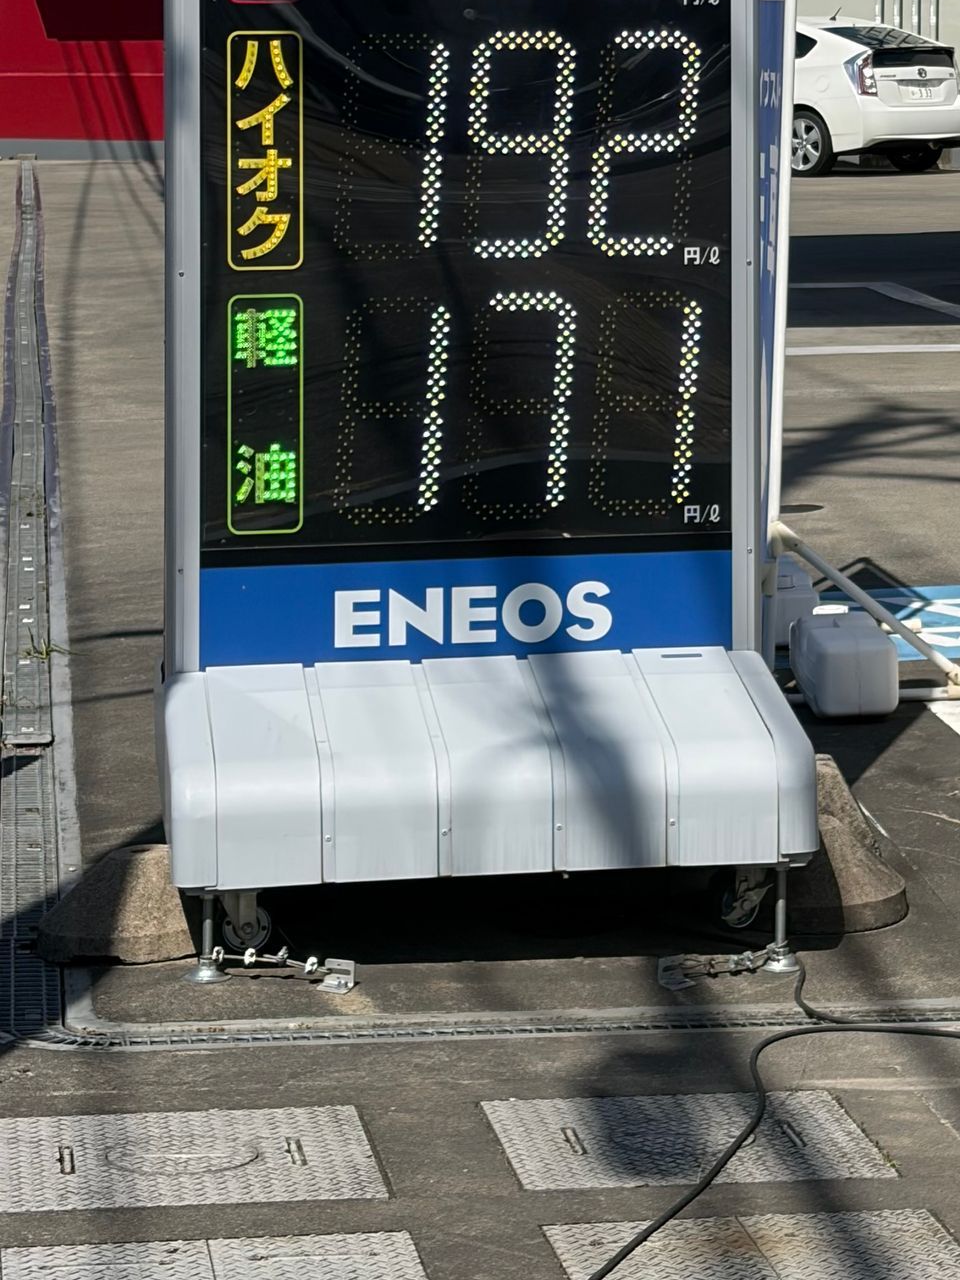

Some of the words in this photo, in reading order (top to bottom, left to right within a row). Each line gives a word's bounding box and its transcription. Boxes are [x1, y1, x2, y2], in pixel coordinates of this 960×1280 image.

[234, 39, 294, 261] ハイオク
[418, 30, 701, 259] 192
[234, 308, 298, 504] 軽油
[418, 292, 701, 511] 177
[334, 581, 613, 649] ENEOS
